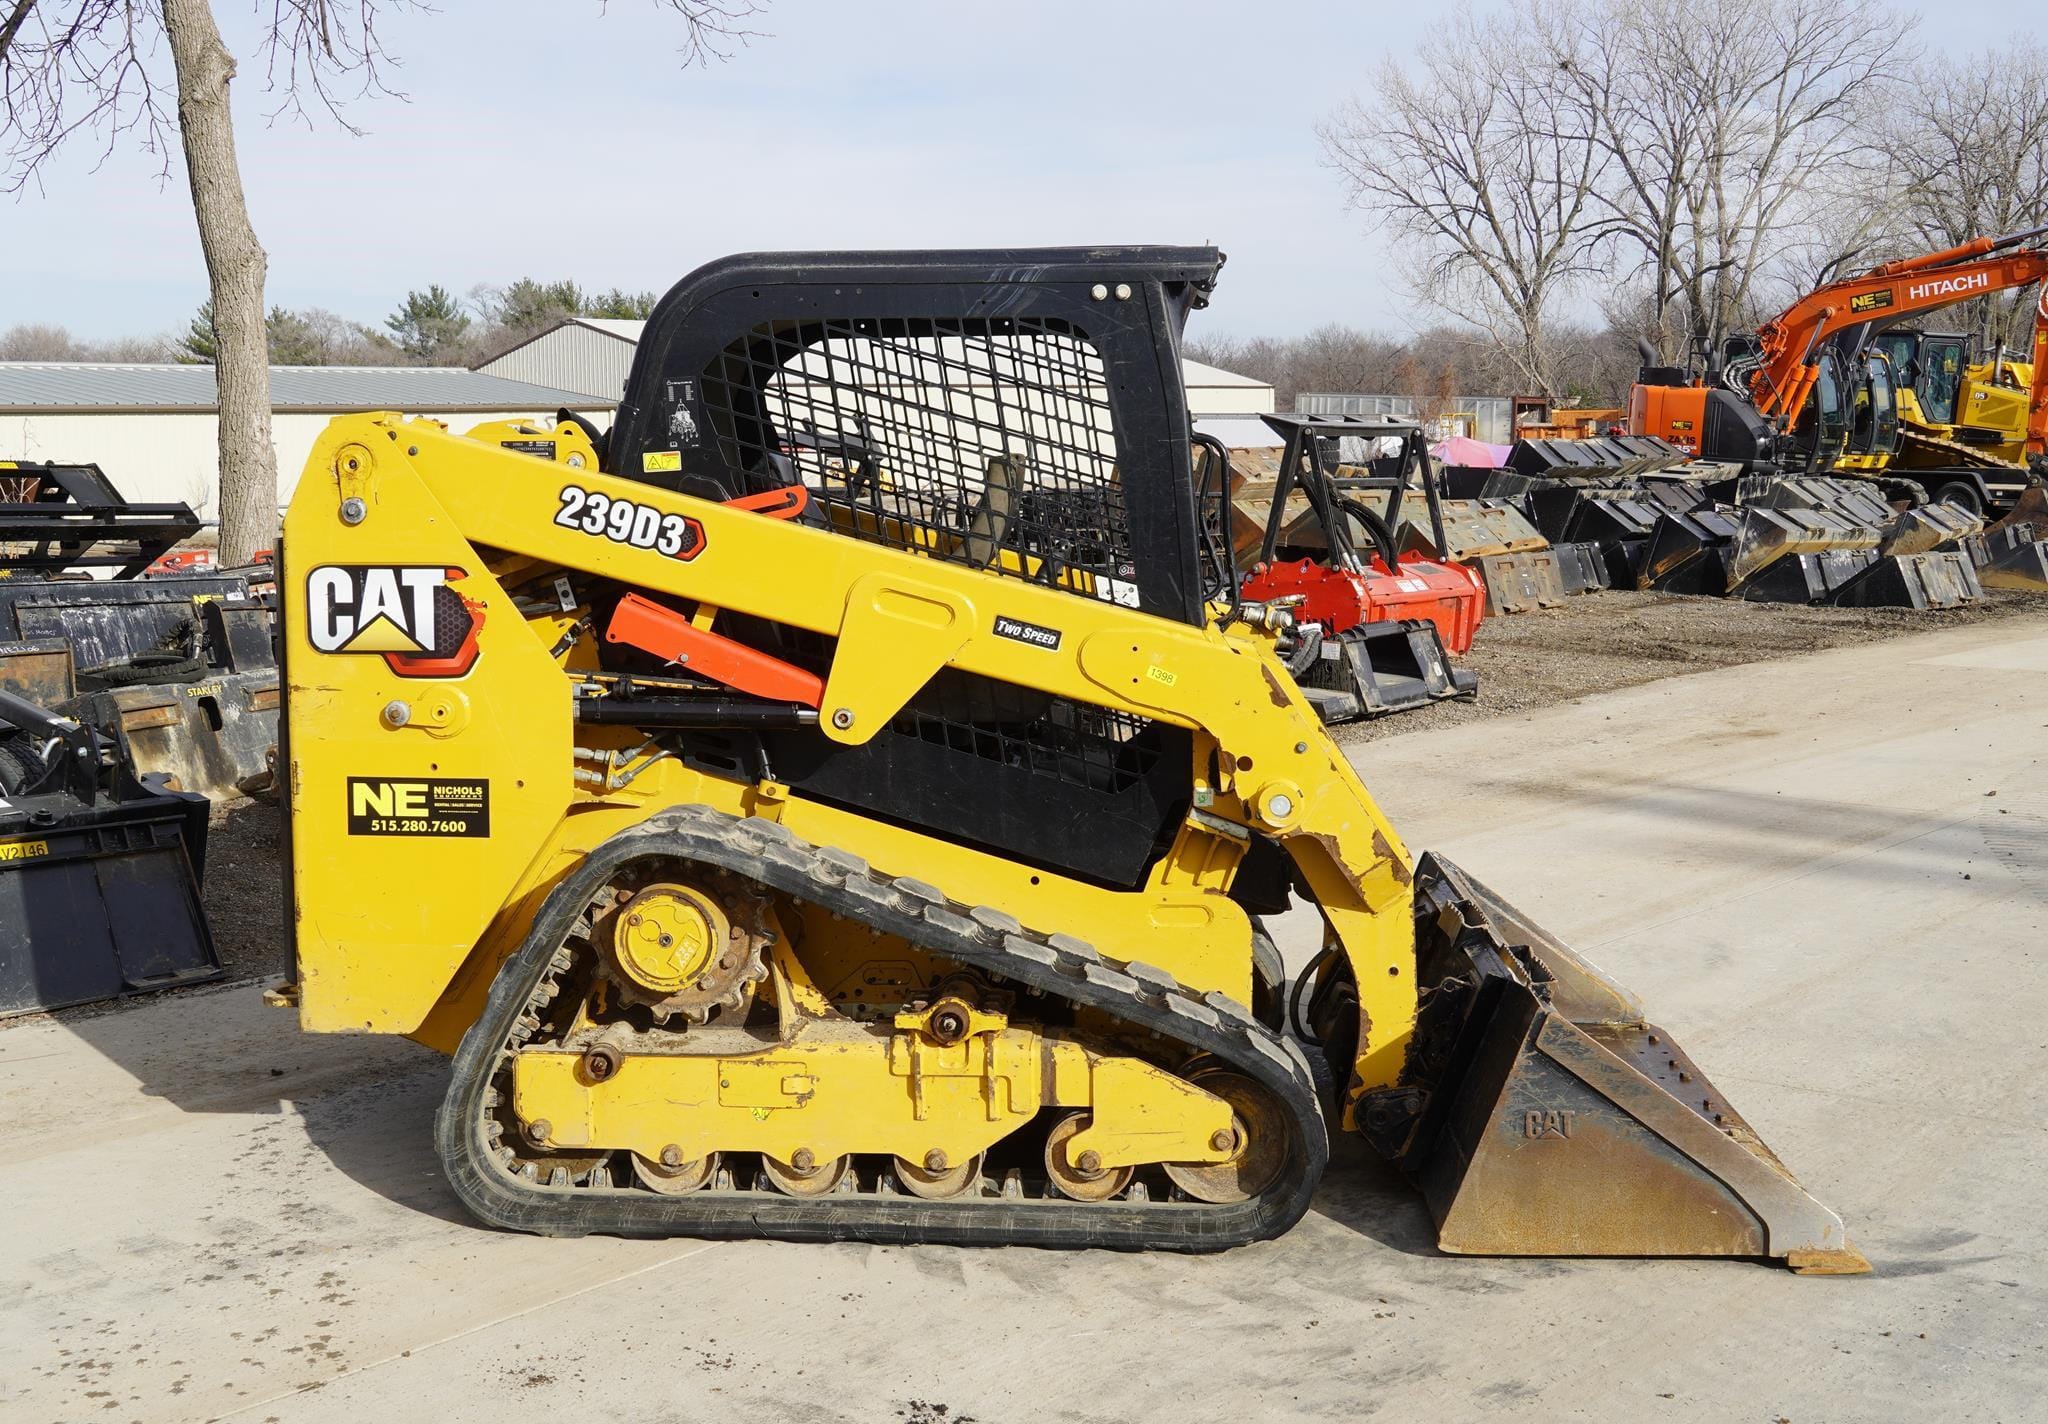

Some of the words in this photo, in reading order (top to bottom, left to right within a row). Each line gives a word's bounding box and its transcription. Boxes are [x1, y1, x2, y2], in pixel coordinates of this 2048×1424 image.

[1909, 272, 1988, 299] HITACHI
[1851, 293, 1875, 308] NE
[555, 486, 686, 555] 239D3
[309, 567, 445, 651] CAT
[997, 620, 1021, 636] TWO
[1022, 628, 1056, 645] SPEED
[1150, 668, 1174, 684] 1398
[353, 783, 429, 817] NE
[433, 786, 483, 795] NICHOLS
[371, 820, 467, 832] 515.280.7600
[1525, 1110, 1575, 1139] CAT
